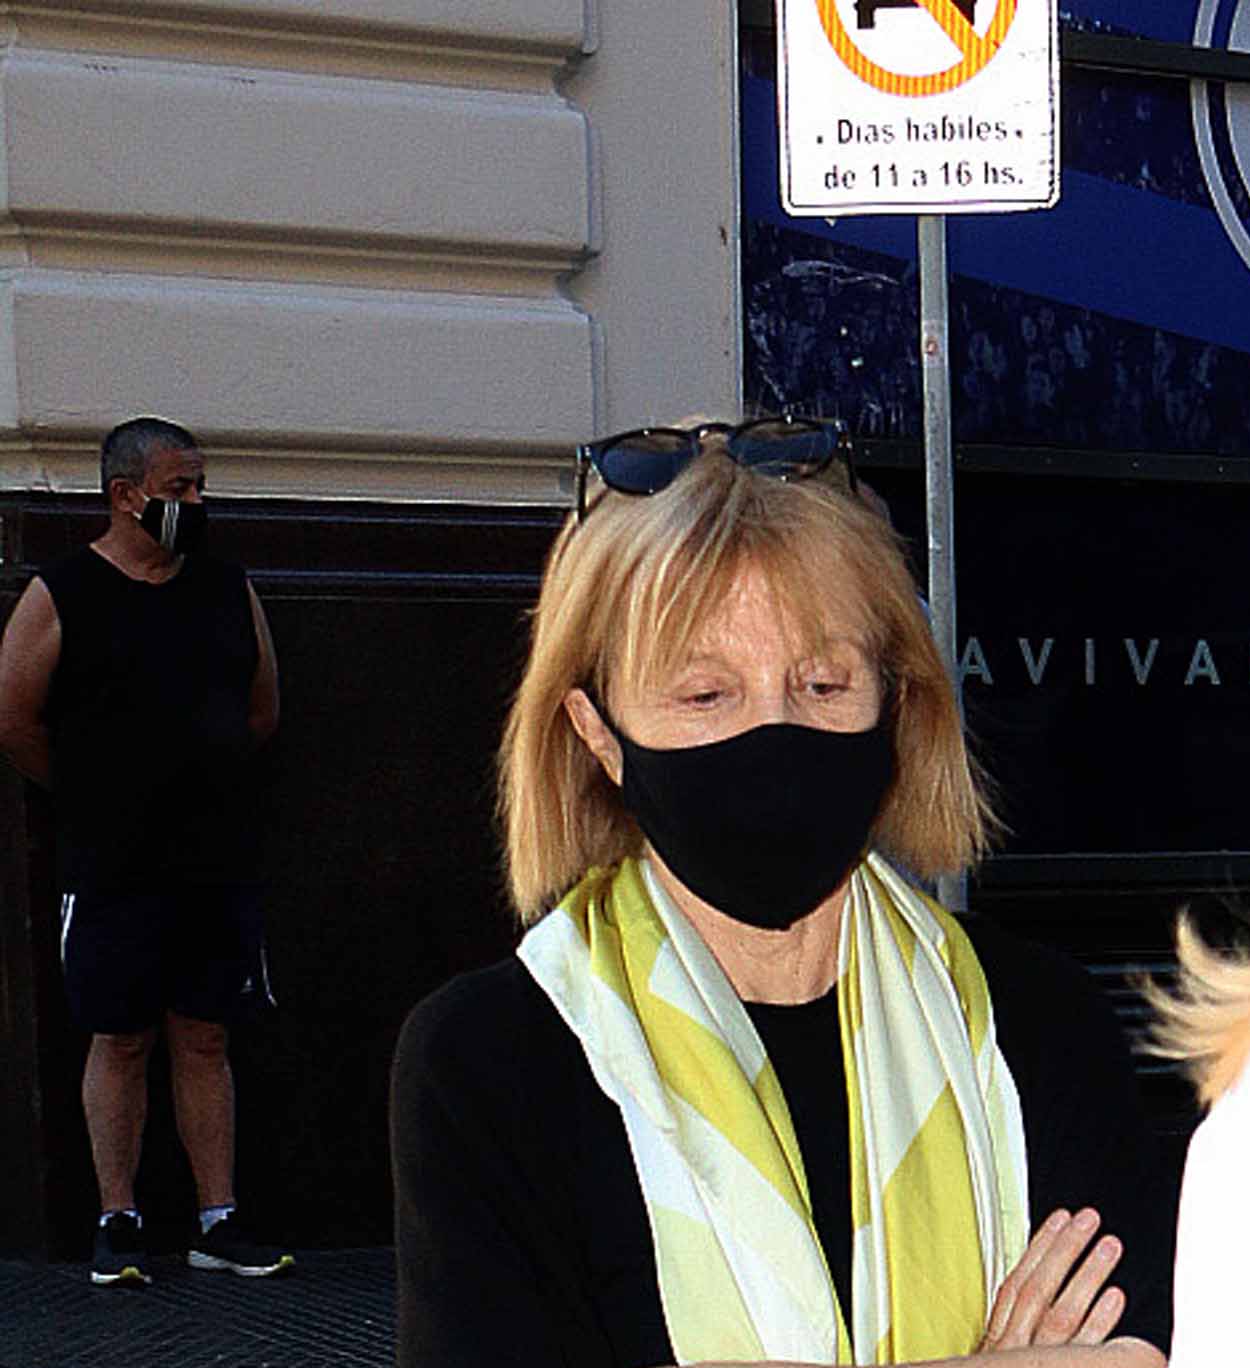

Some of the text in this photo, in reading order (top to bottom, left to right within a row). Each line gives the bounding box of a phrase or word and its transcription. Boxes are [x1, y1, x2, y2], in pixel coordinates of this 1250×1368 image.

[824, 160, 1024, 189] de 11 a 16 hs.
